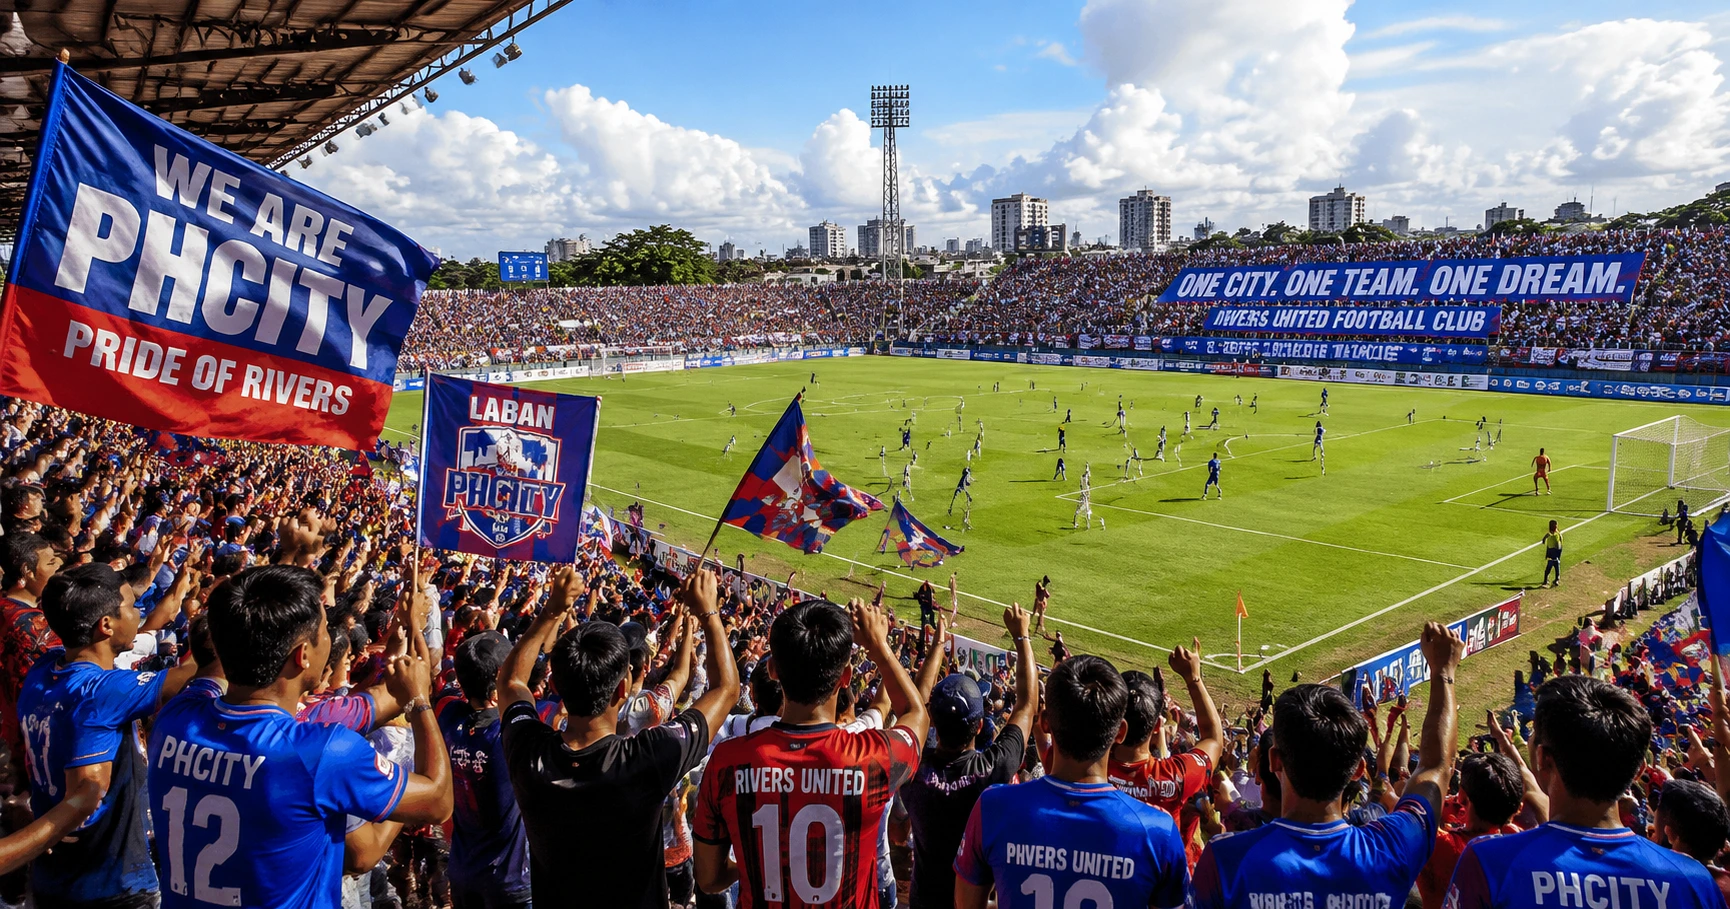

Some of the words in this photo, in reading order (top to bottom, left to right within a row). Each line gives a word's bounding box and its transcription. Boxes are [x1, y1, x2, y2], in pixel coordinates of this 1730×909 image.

[154, 143, 241, 224] WE
[250, 192, 354, 267] ARE
[54, 182, 393, 370] PHCITY
[1177, 272, 1224, 297] ONE
[1224, 271, 1280, 297] CITY.
[1284, 269, 1337, 296] ONE
[1344, 267, 1419, 296] TEAM.
[1429, 264, 1493, 295] ONE
[1496, 262, 1626, 295] DREAM.
[1332, 309, 1425, 331] FOOTBALL
[1432, 310, 1486, 332] CLUB
[63, 319, 187, 385] PRIDE
[191, 354, 237, 394] OF
[241, 365, 353, 416] RIVERS
[470, 395, 555, 430] LABAN
[157, 735, 266, 790] PHCITY
[735, 767, 795, 795] RIVERS
[800, 768, 865, 796] UNITED
[162, 786, 242, 907] 12
[752, 803, 847, 905] 10
[1072, 849, 1135, 880] UNITED
[1531, 871, 1670, 909] PHCITY
